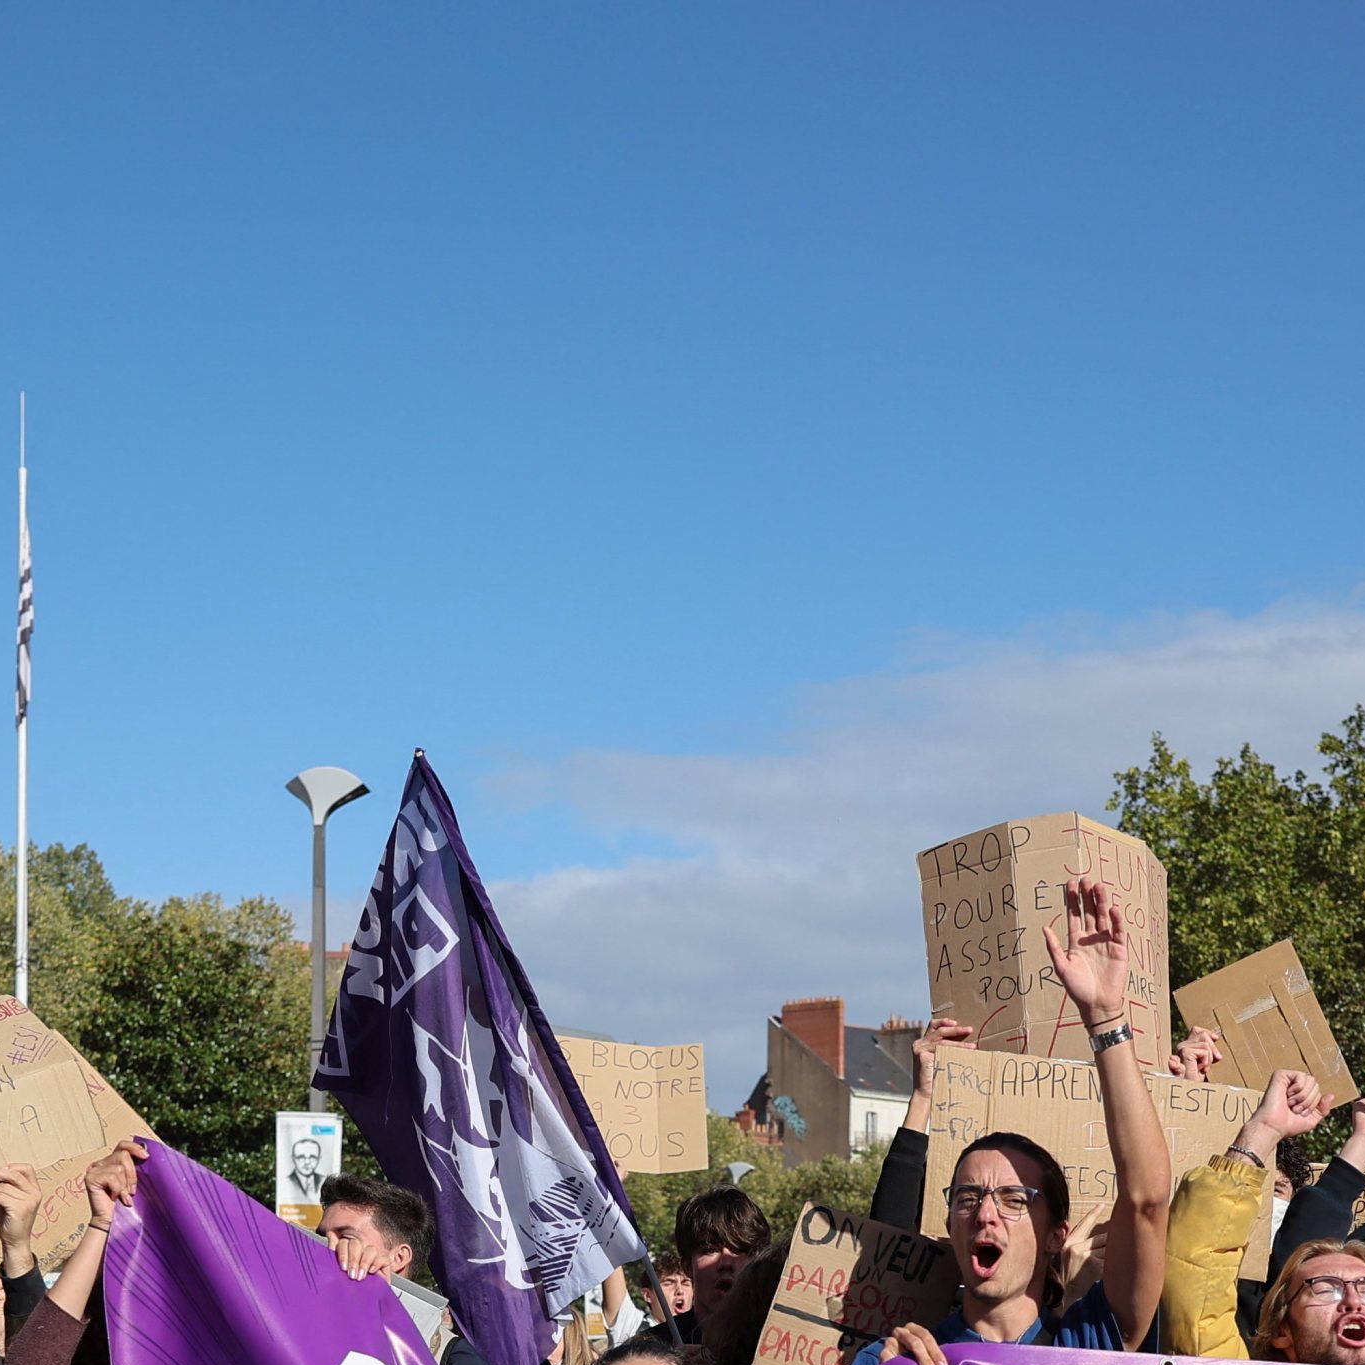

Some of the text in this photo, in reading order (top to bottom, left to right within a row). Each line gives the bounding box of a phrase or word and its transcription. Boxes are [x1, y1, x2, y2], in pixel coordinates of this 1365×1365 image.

[922, 825, 1031, 888] TROP
[934, 883, 1019, 937] POUR
[936, 927, 1027, 982] ASSEZ
[979, 965, 1158, 1006] POUR AIRE
[592, 1041, 699, 1071] BLOCUS
[614, 1076, 702, 1100] NOTRE
[1171, 1084, 1216, 1116] EST
[20, 1105, 43, 1133] A
[801, 1206, 946, 1285] ON VEUT
[856, 1264, 885, 1283] UN
